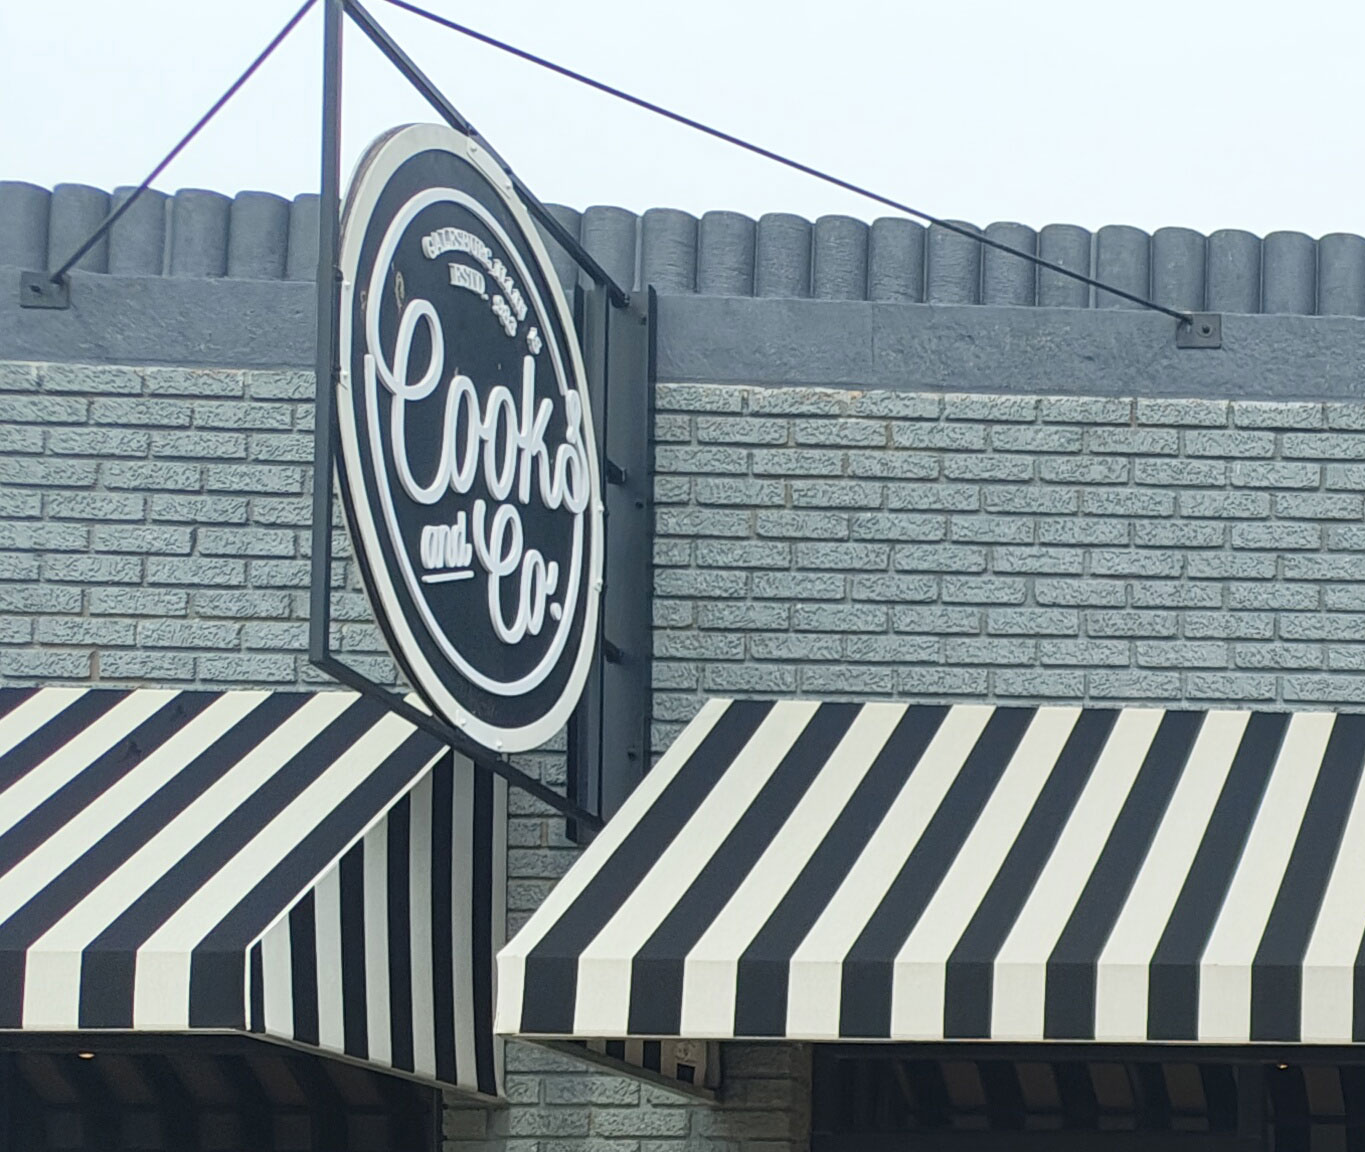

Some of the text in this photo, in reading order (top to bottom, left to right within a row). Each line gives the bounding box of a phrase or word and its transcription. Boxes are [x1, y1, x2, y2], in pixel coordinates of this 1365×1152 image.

[366, 298, 591, 514] Cooks
[420, 499, 563, 644] and Co.
